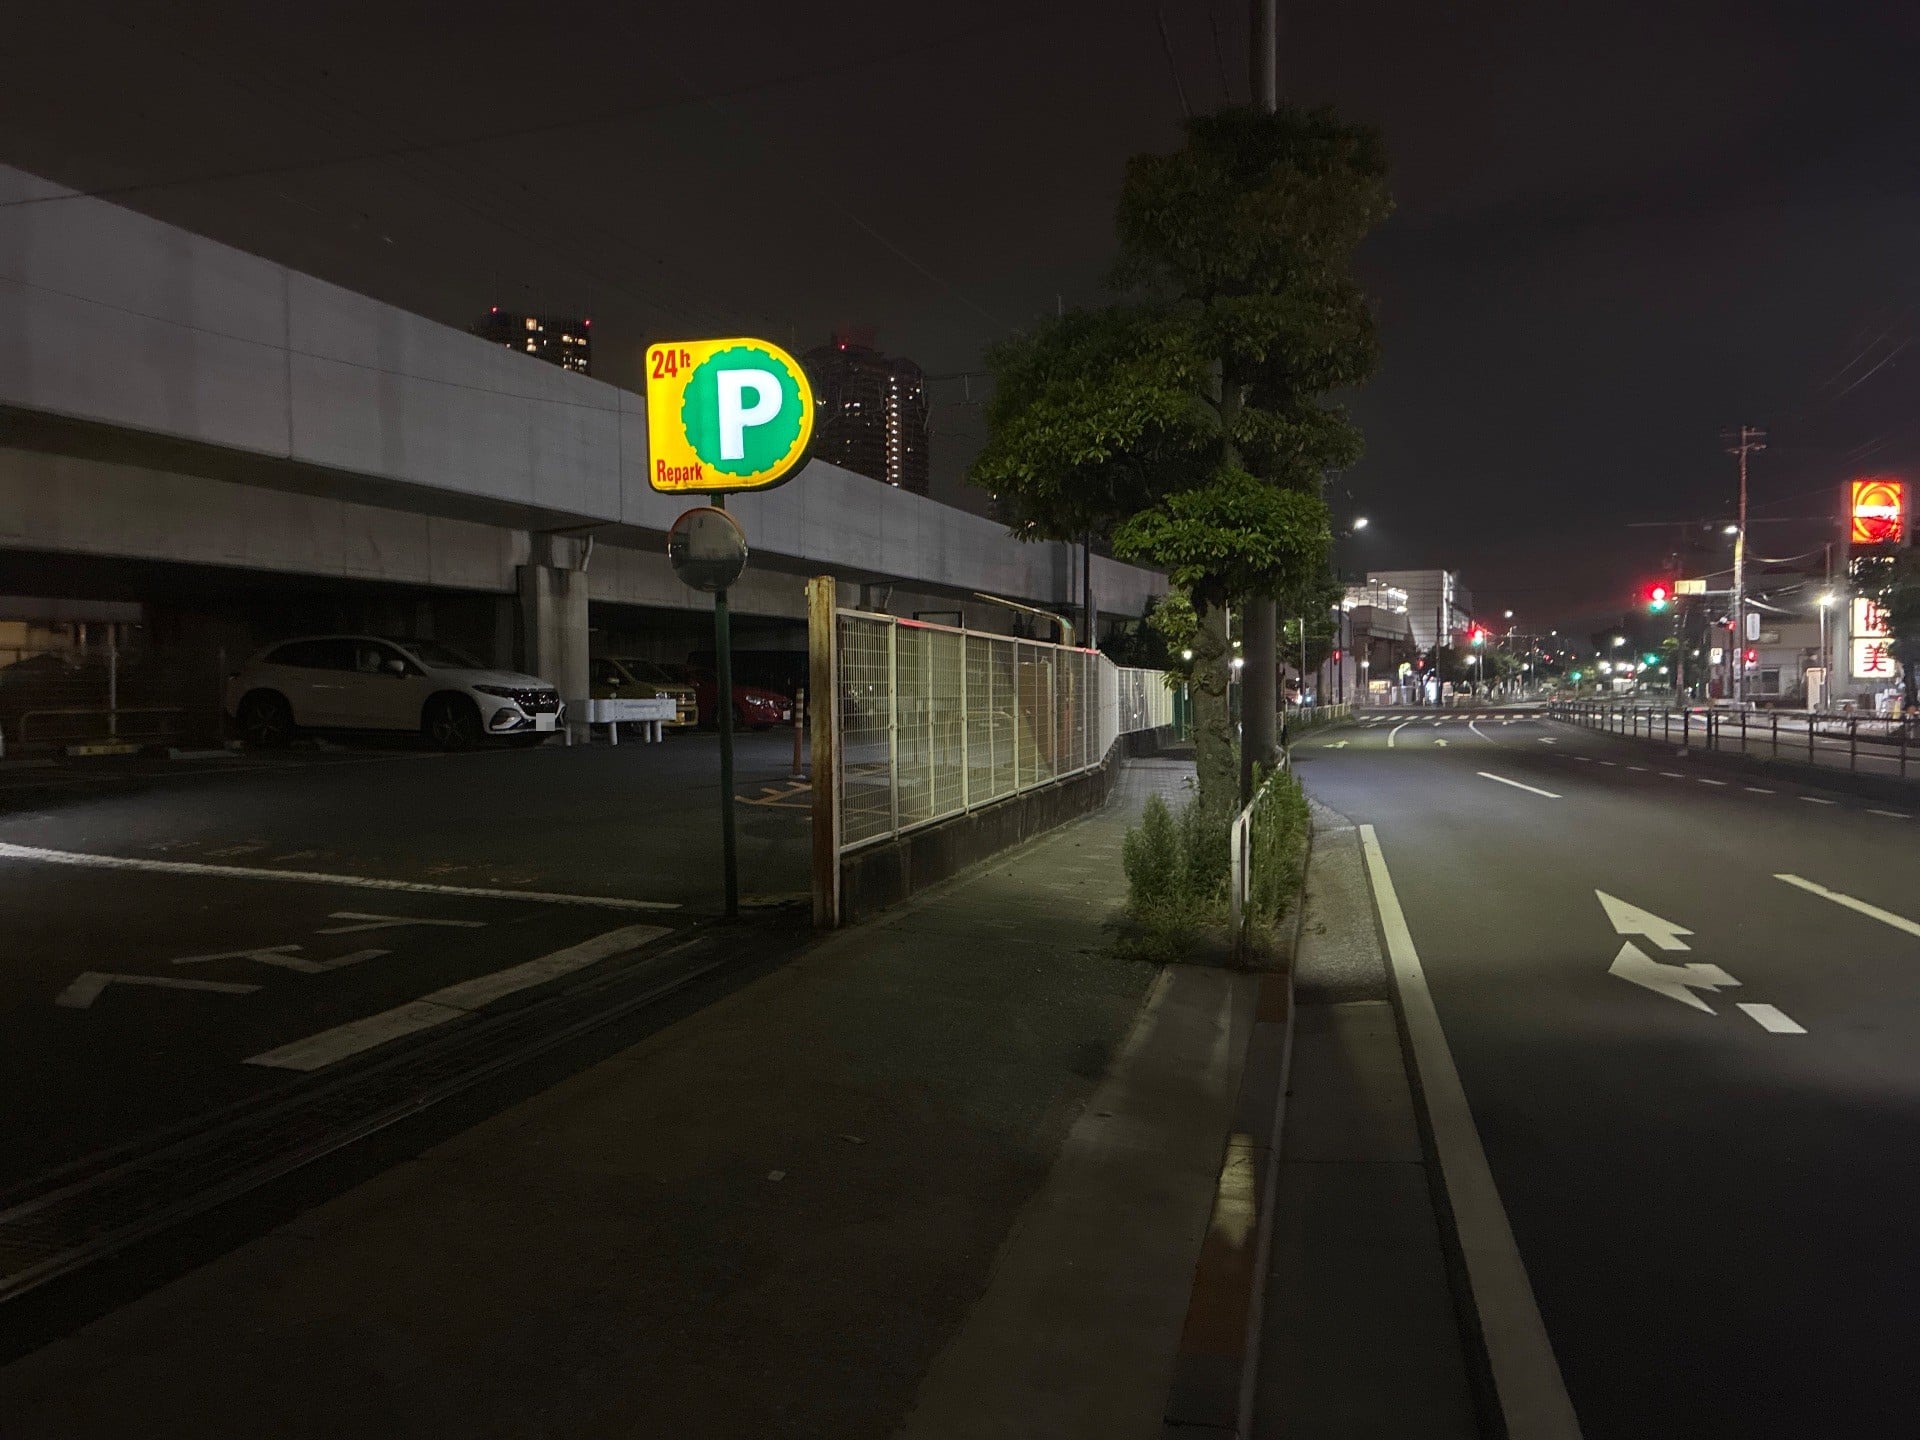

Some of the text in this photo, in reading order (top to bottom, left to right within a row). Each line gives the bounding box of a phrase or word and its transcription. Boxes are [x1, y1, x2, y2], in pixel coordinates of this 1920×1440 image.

[652, 349, 691, 379] 24h
[716, 368, 783, 460] P
[656, 459, 703, 485] Repark
